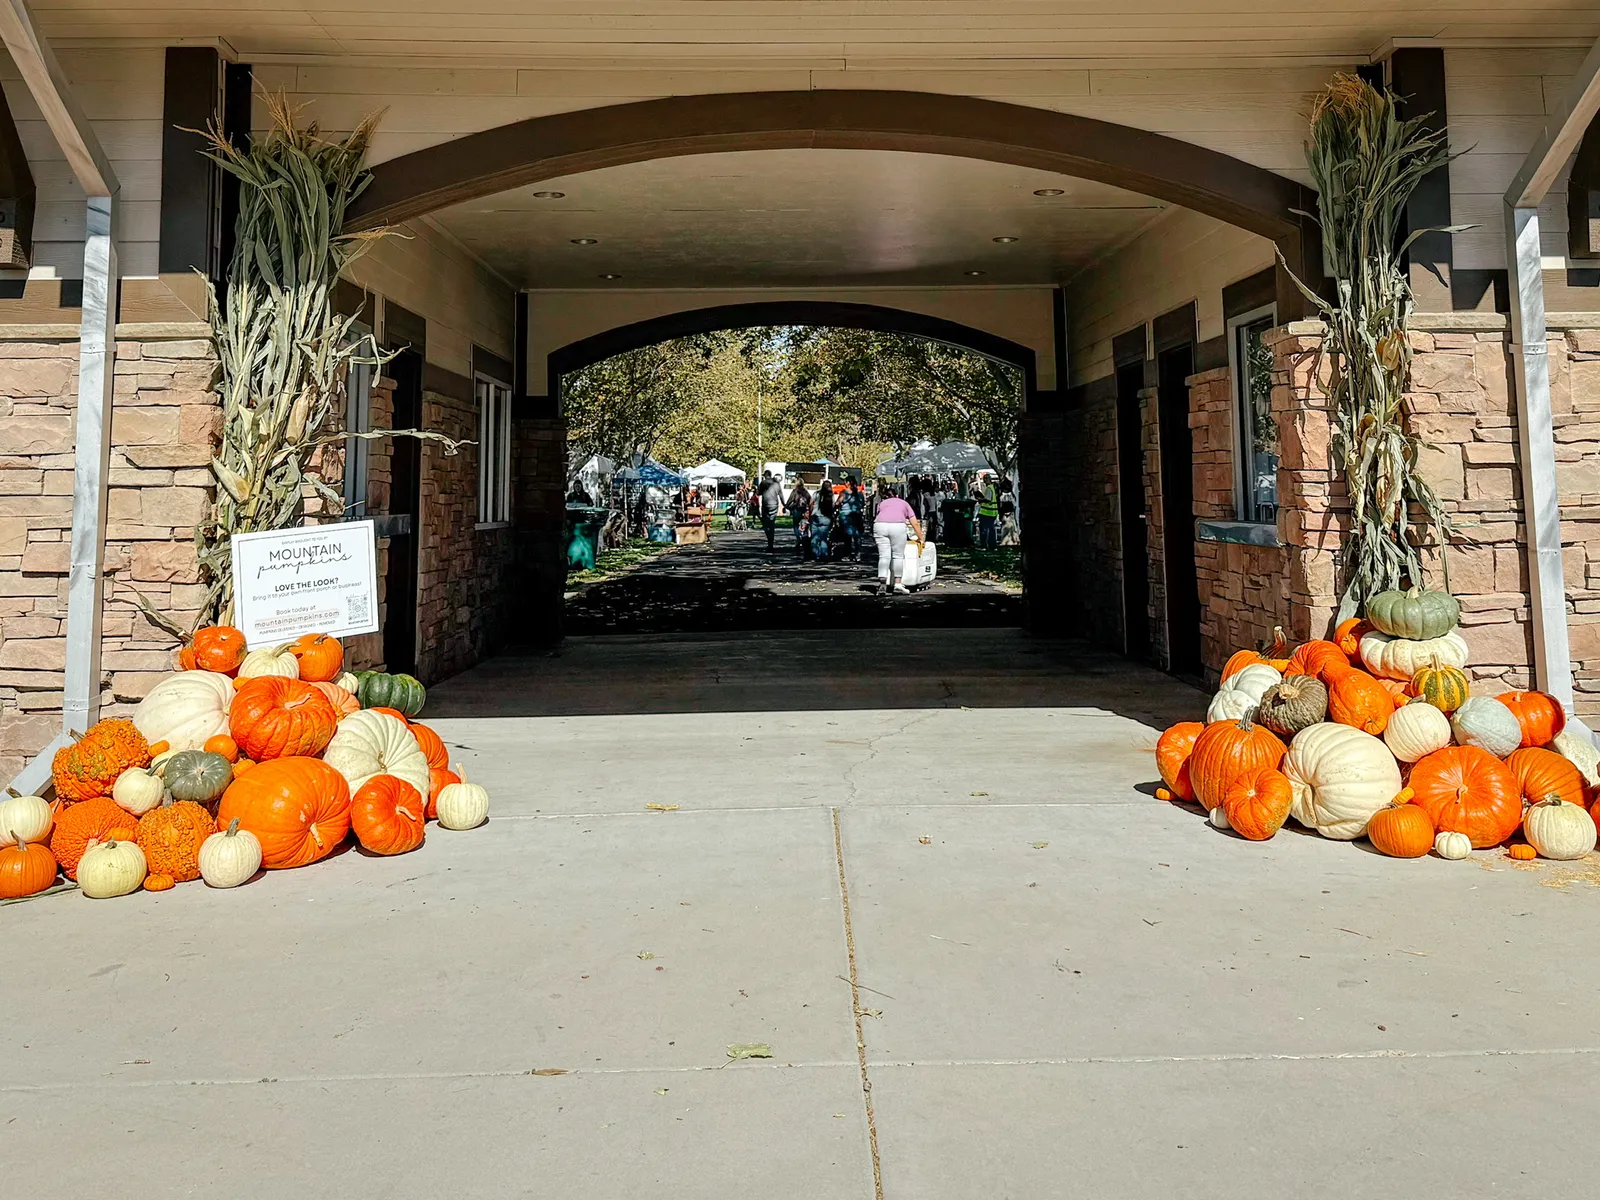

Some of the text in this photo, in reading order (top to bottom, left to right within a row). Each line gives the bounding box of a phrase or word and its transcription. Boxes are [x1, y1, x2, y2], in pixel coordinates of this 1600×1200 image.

[269, 543, 342, 562] MOUNTAIN
[257, 550, 352, 579] pumpkins
[274, 577, 338, 592] LOVE THE LOOK?
[338, 581, 362, 589] business!
[254, 610, 340, 628] mountainpumpkins.com
